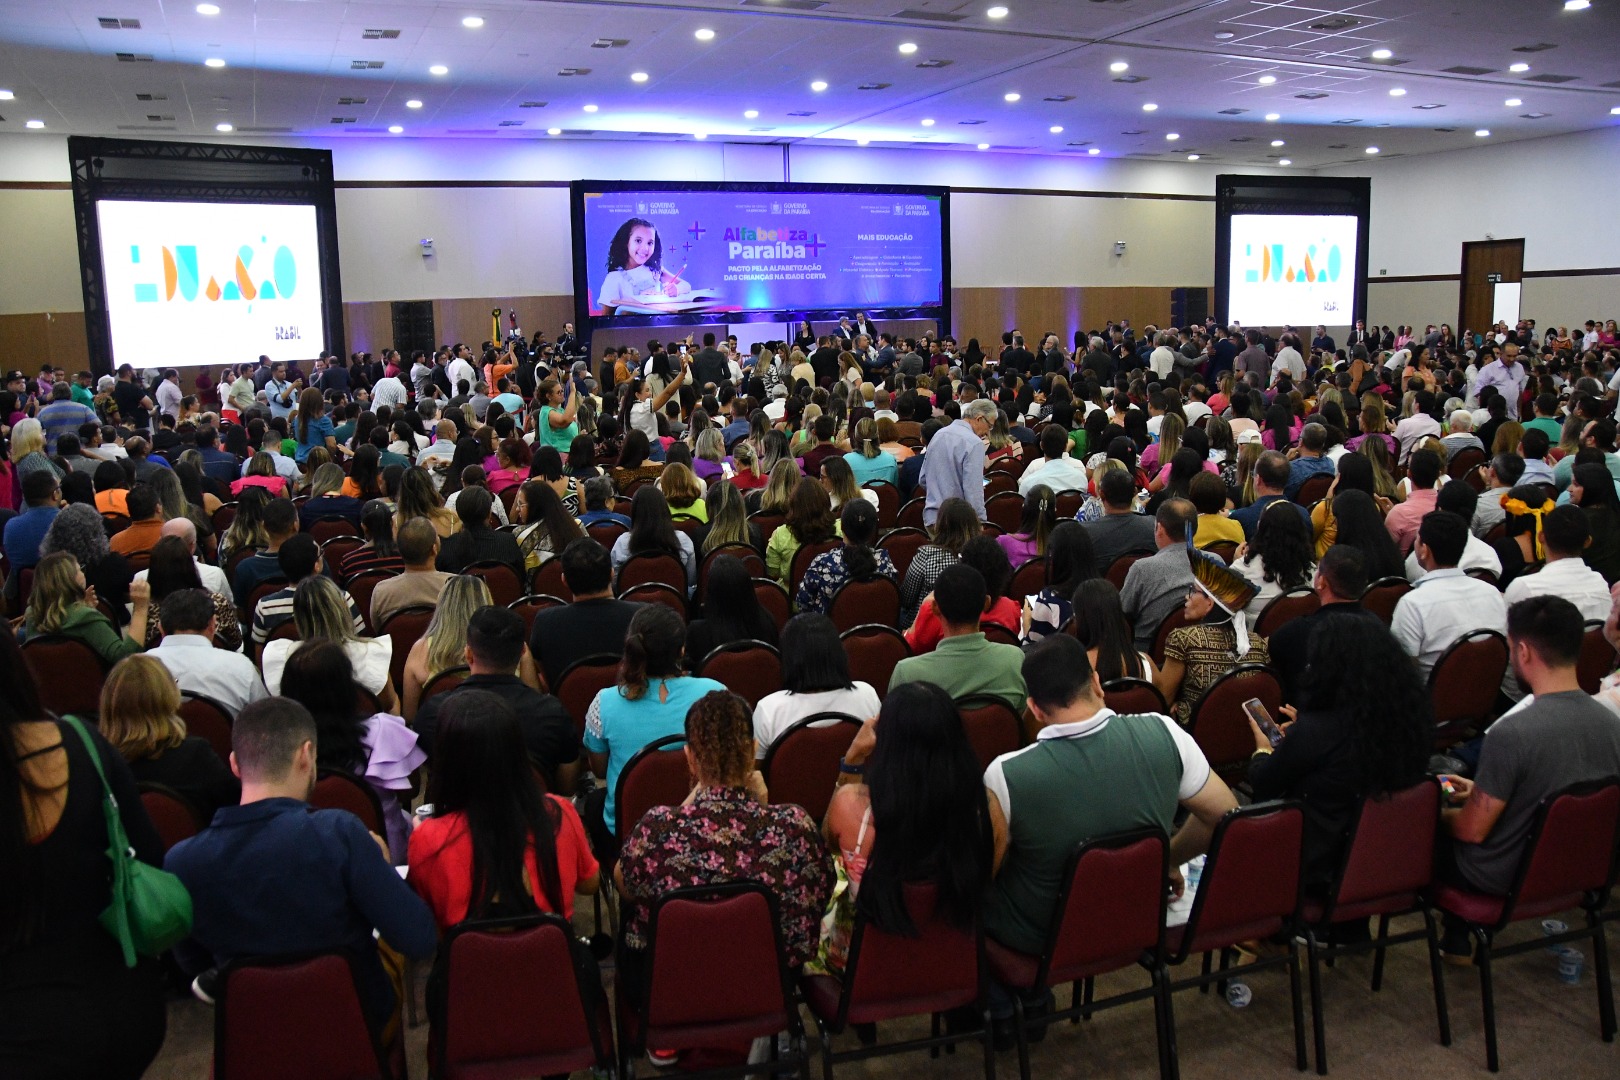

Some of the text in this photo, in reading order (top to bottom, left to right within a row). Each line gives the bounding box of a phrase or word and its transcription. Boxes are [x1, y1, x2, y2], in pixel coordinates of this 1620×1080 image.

[723, 226, 808, 241] Alfabetiza
[876, 233, 913, 242] EDUCAÇÃO
[728, 241, 806, 260] Paraíba
[769, 263, 822, 272] ALFABETIZAÇÃO
